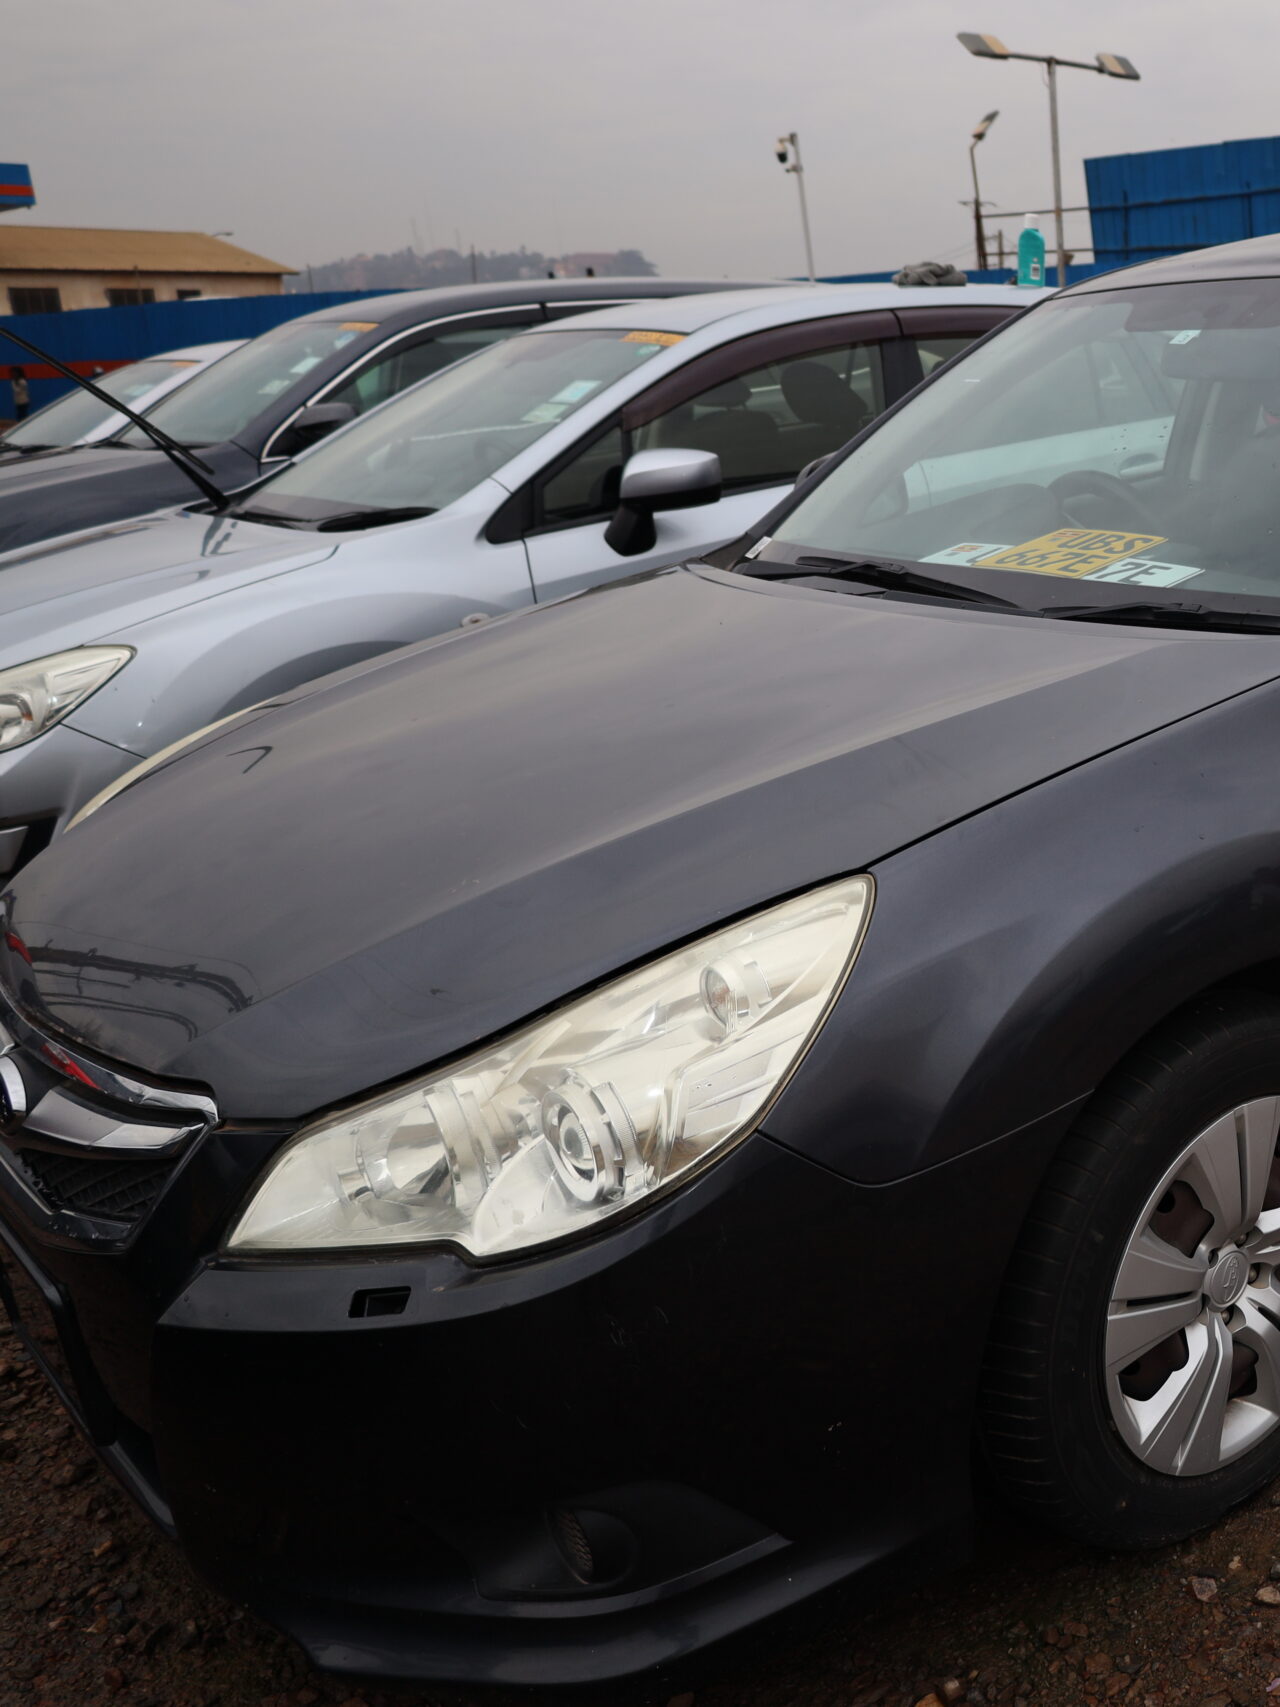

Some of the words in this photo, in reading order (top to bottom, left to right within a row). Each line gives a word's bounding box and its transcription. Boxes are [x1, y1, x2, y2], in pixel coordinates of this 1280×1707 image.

[1057, 531, 1154, 555] UBS
[995, 548, 1111, 574] 667E
[1094, 560, 1174, 586] 7E
